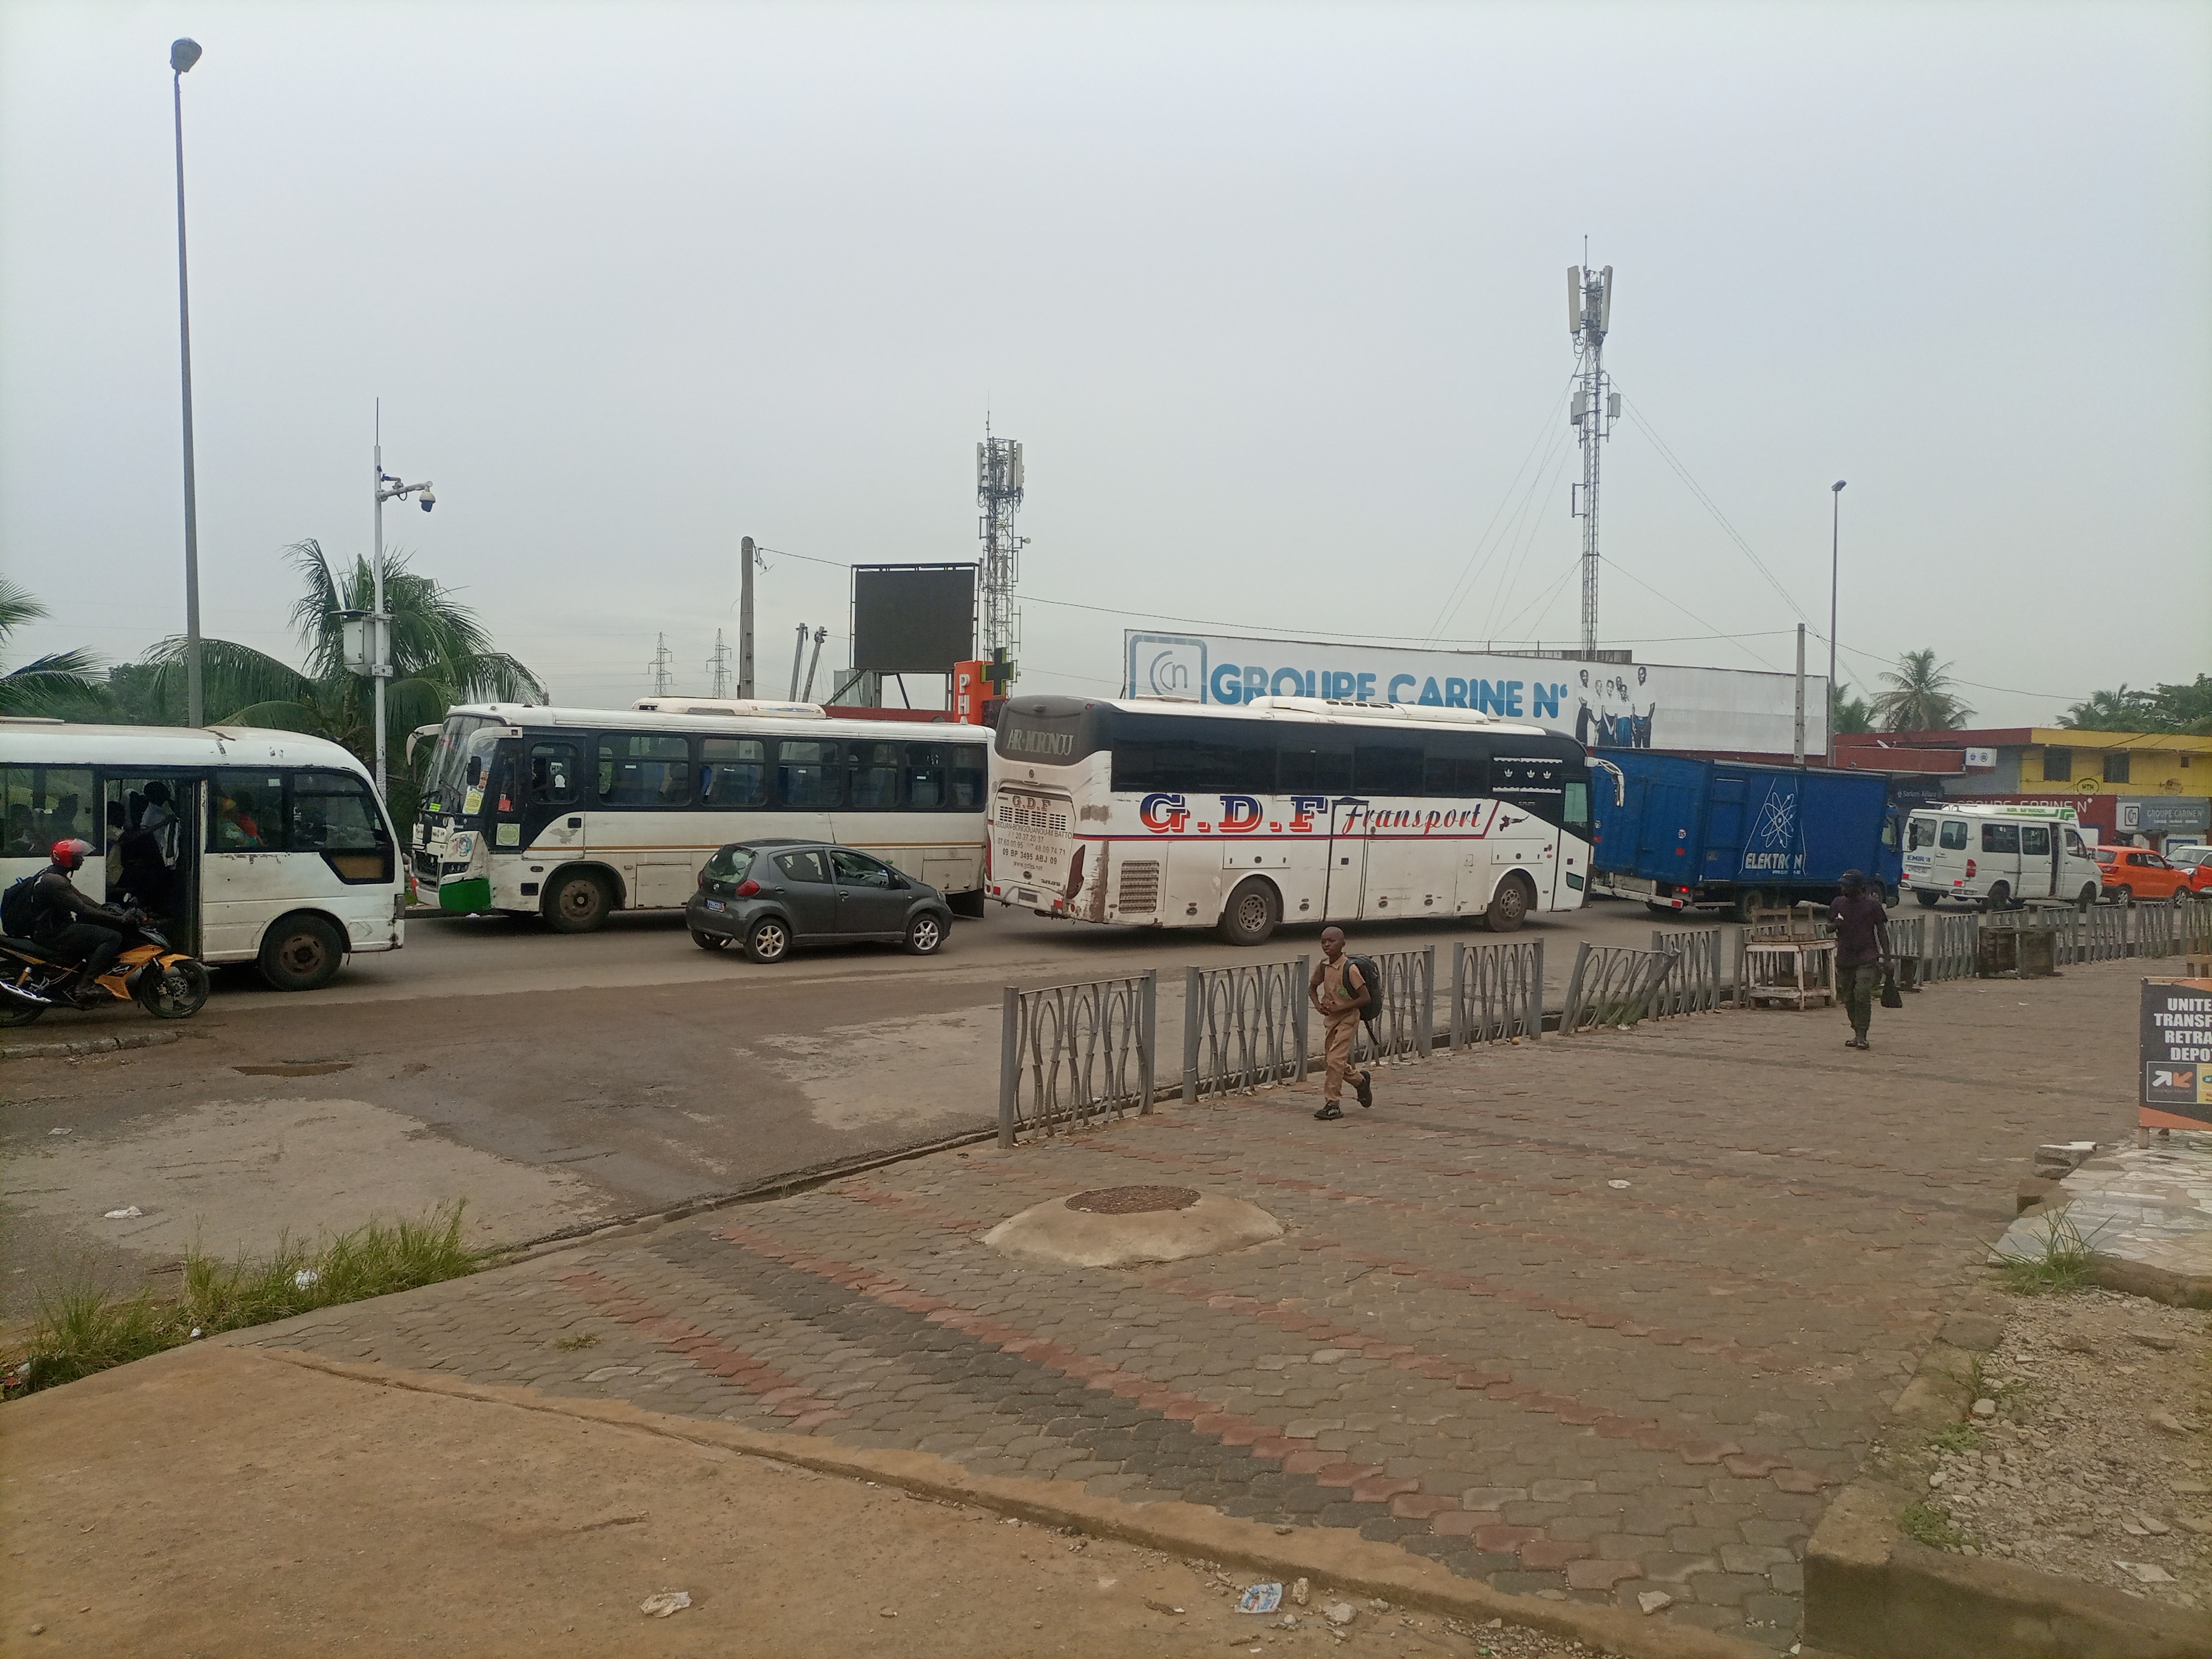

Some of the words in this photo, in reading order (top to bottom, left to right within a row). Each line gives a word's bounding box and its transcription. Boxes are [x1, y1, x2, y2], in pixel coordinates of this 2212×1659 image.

[1210, 663, 1376, 705] GROUPE
[1388, 673, 1524, 717] CARINE
[1006, 729, 1022, 750] AIR
[1025, 730, 1074, 756] MORONOU
[1010, 850, 1018, 858] BP
[1020, 851, 1033, 860] 3495
[1035, 854, 1047, 863] ABJ
[2167, 998, 2212, 1012] UNITE
[2165, 1030, 2212, 1044] RETRA
[2170, 1047, 2212, 1062] DEPO
